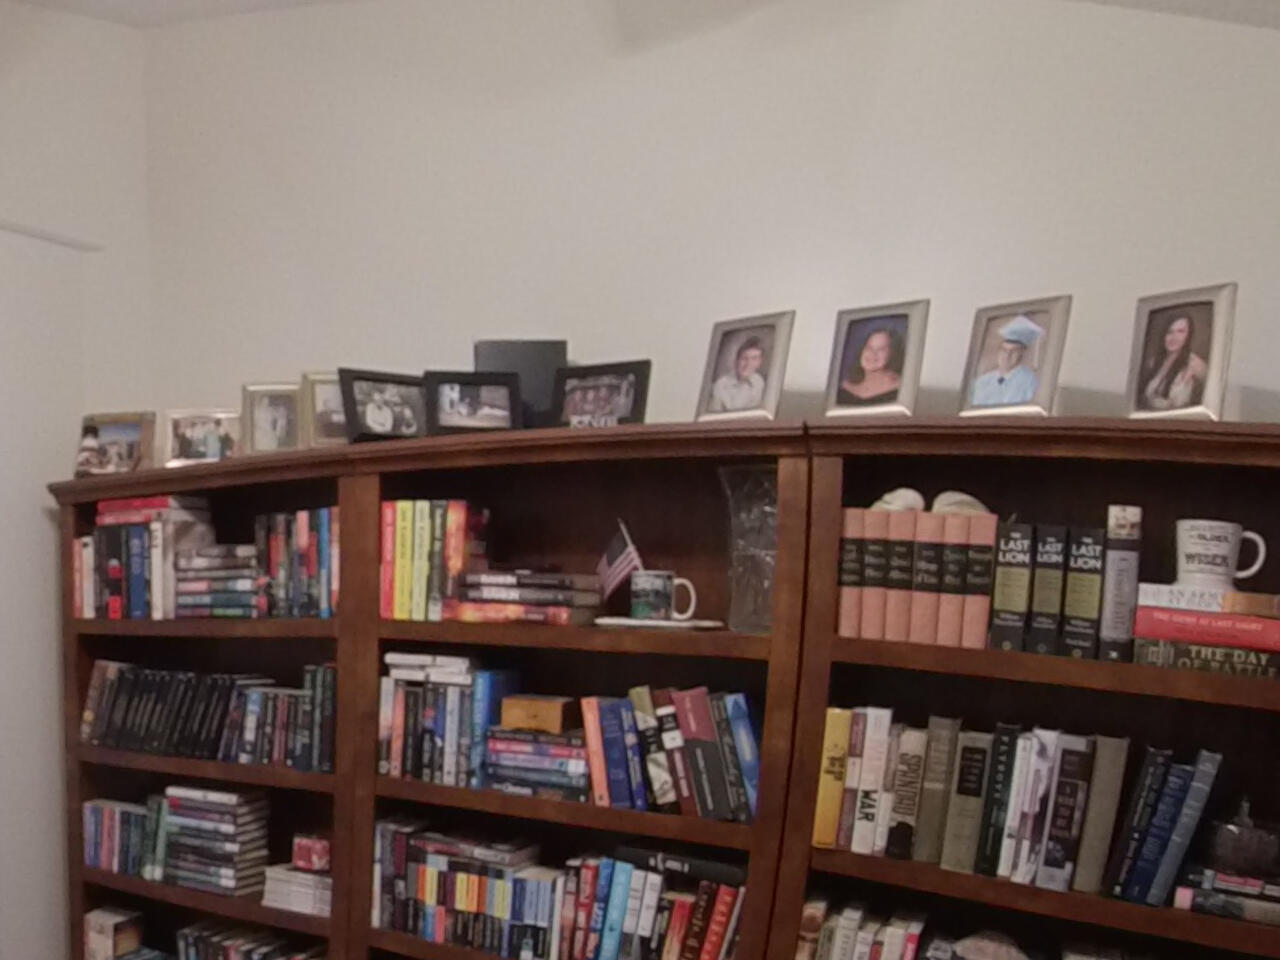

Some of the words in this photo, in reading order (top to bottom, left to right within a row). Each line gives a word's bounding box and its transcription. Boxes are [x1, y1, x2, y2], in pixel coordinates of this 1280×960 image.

[1000, 538, 1030, 551] LAST
[1038, 542, 1064, 552] LAST
[1072, 544, 1103, 556] LAST
[998, 551, 1030, 564] LION
[1036, 552, 1063, 563] LION
[1069, 557, 1102, 569] LION
[1188, 646, 1225, 660] THE
[1233, 650, 1270, 666] DAY
[892, 752, 923, 817] SPANDAU
[856, 789, 879, 824] WAR
